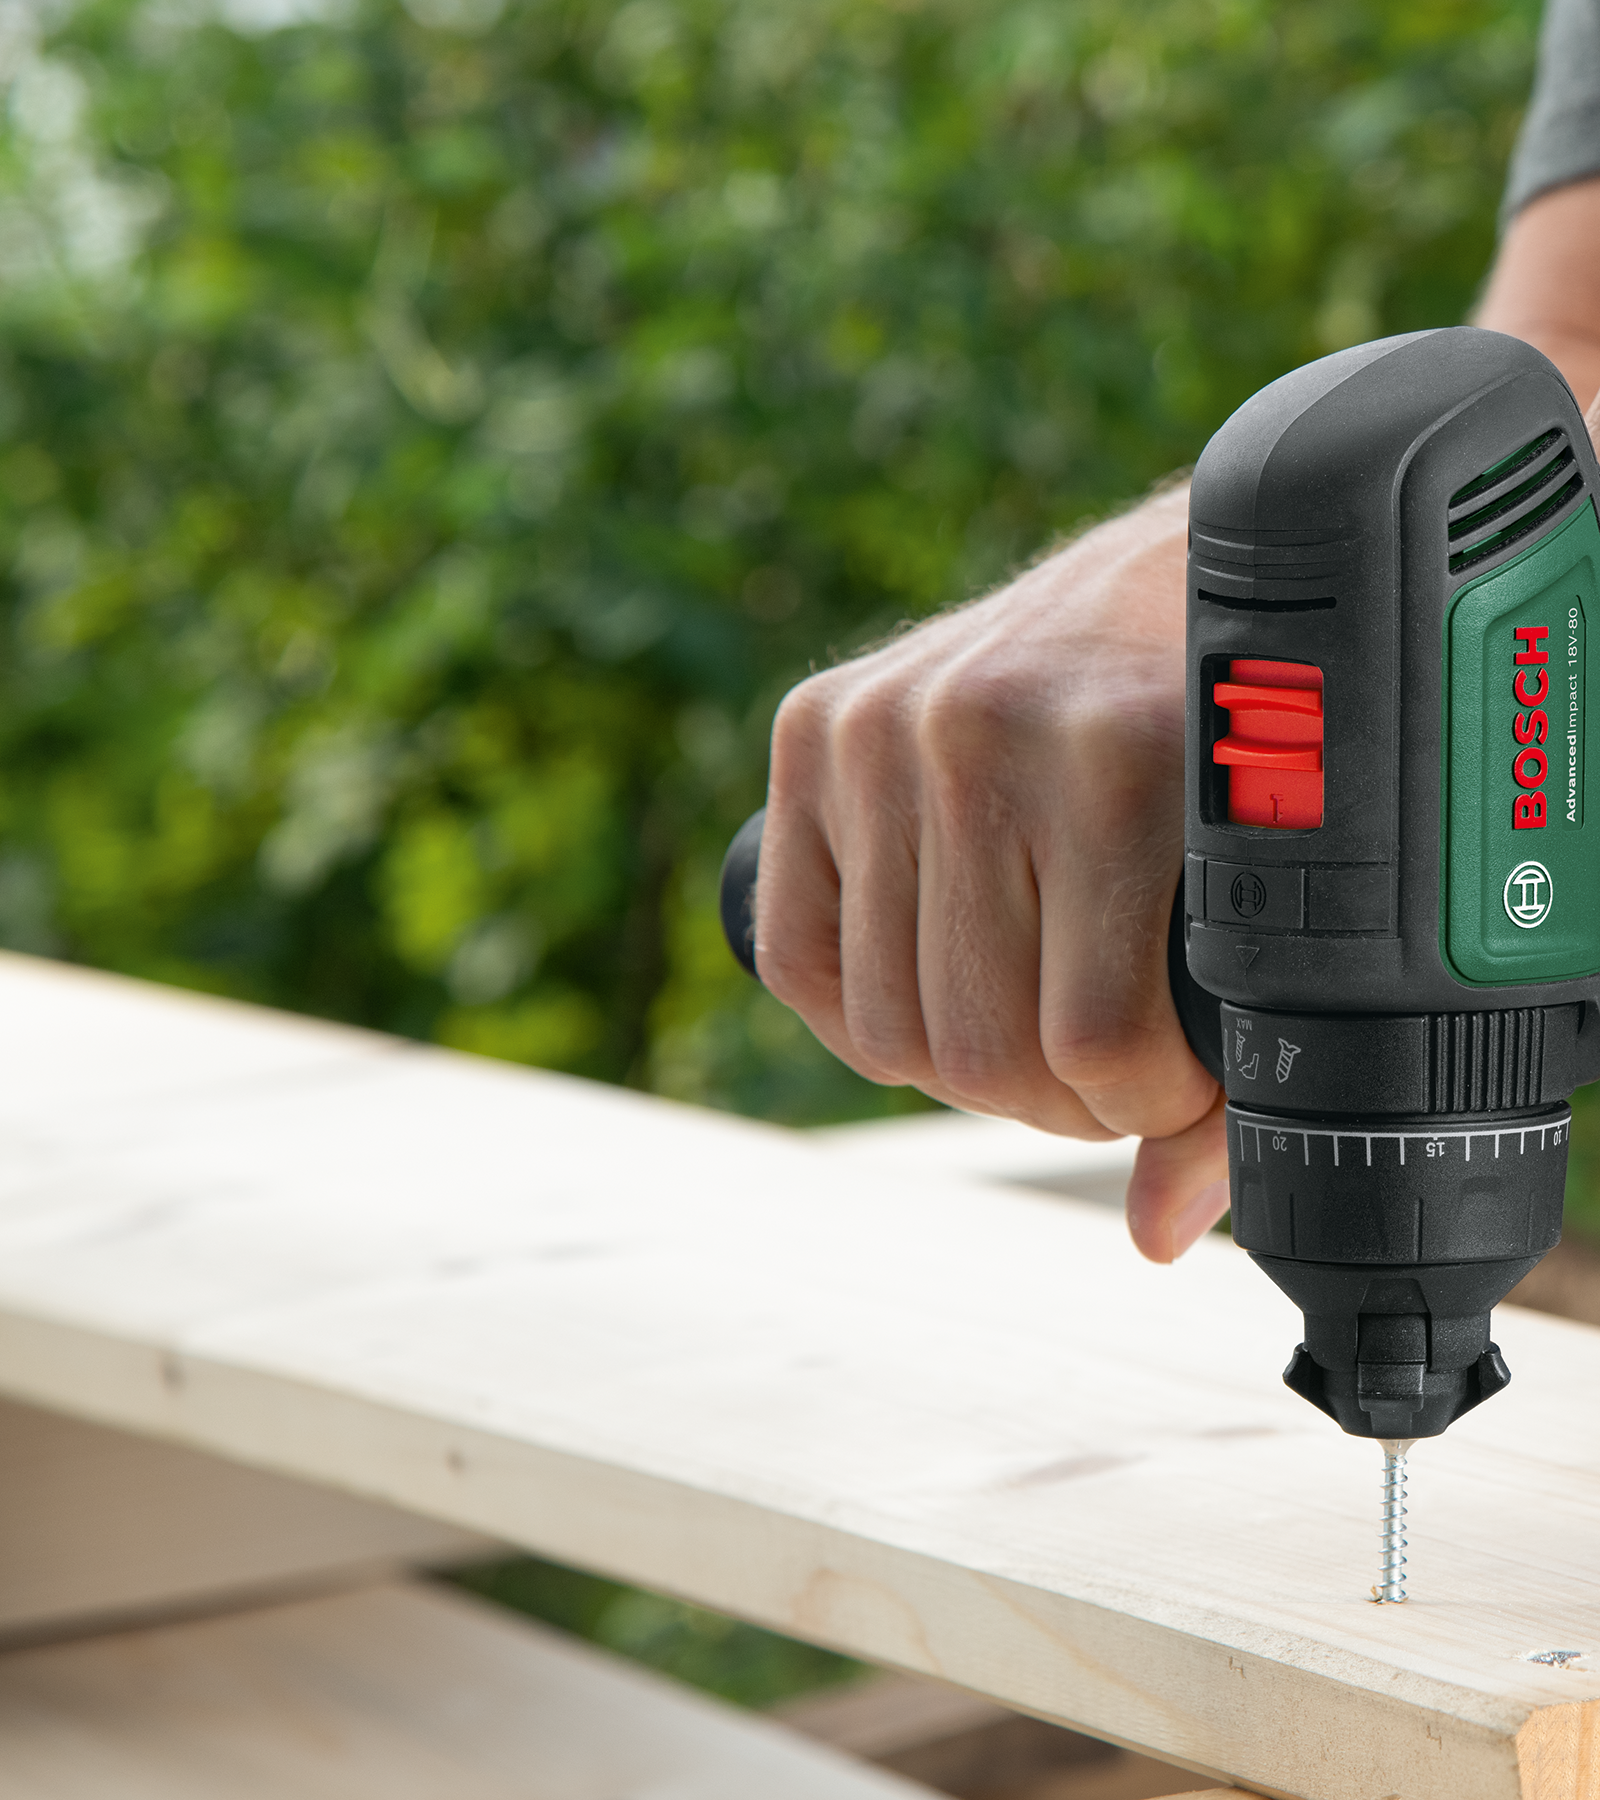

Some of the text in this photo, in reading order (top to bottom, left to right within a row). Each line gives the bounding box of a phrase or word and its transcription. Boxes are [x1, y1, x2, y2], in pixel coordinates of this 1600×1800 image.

[1513, 626, 1550, 830] BOSCH
[1566, 607, 1580, 822] AdvancedImpact 18V-80
[1235, 1017, 1253, 1031] MAX
[1272, 1128, 1562, 1158] 20 15 10
